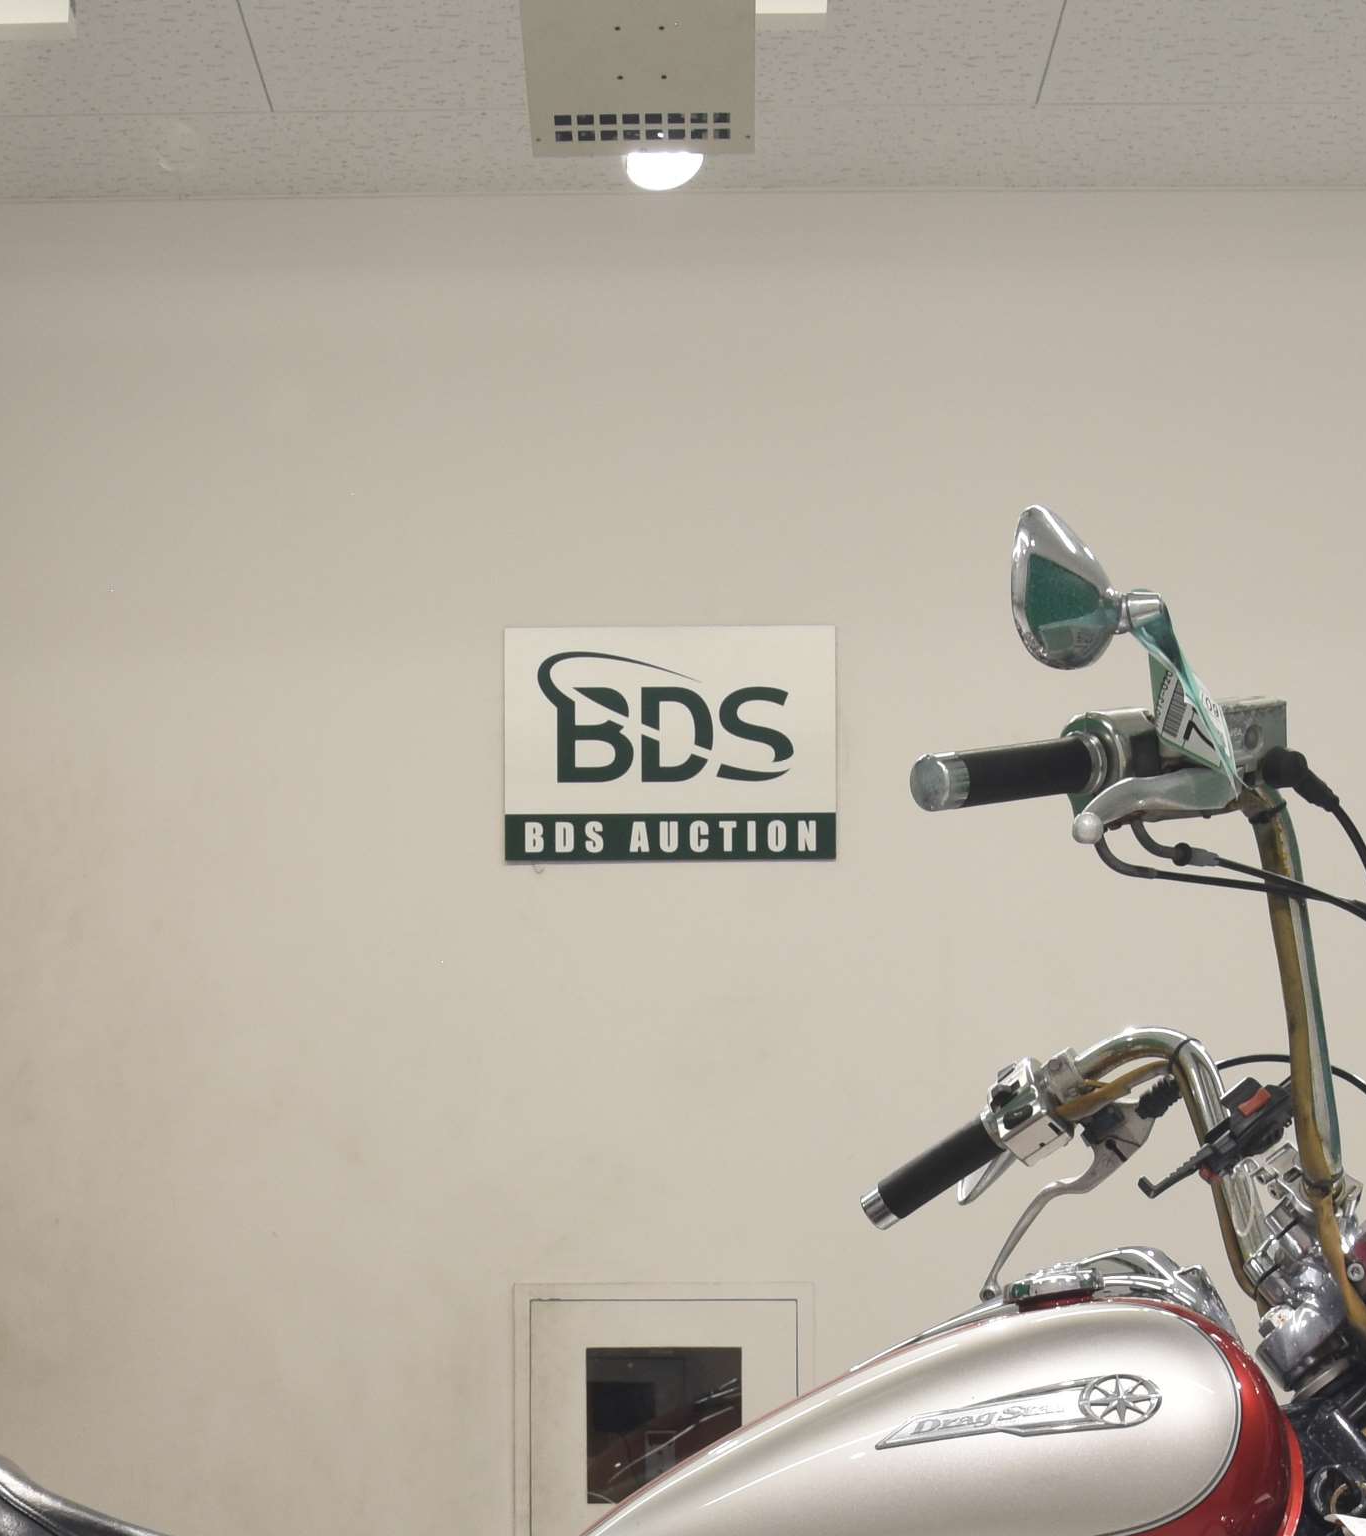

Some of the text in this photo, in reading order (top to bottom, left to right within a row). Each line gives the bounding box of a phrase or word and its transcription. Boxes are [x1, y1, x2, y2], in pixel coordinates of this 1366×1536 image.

[537, 651, 794, 783] BDS
[524, 820, 818, 853] BDS AUCTION
